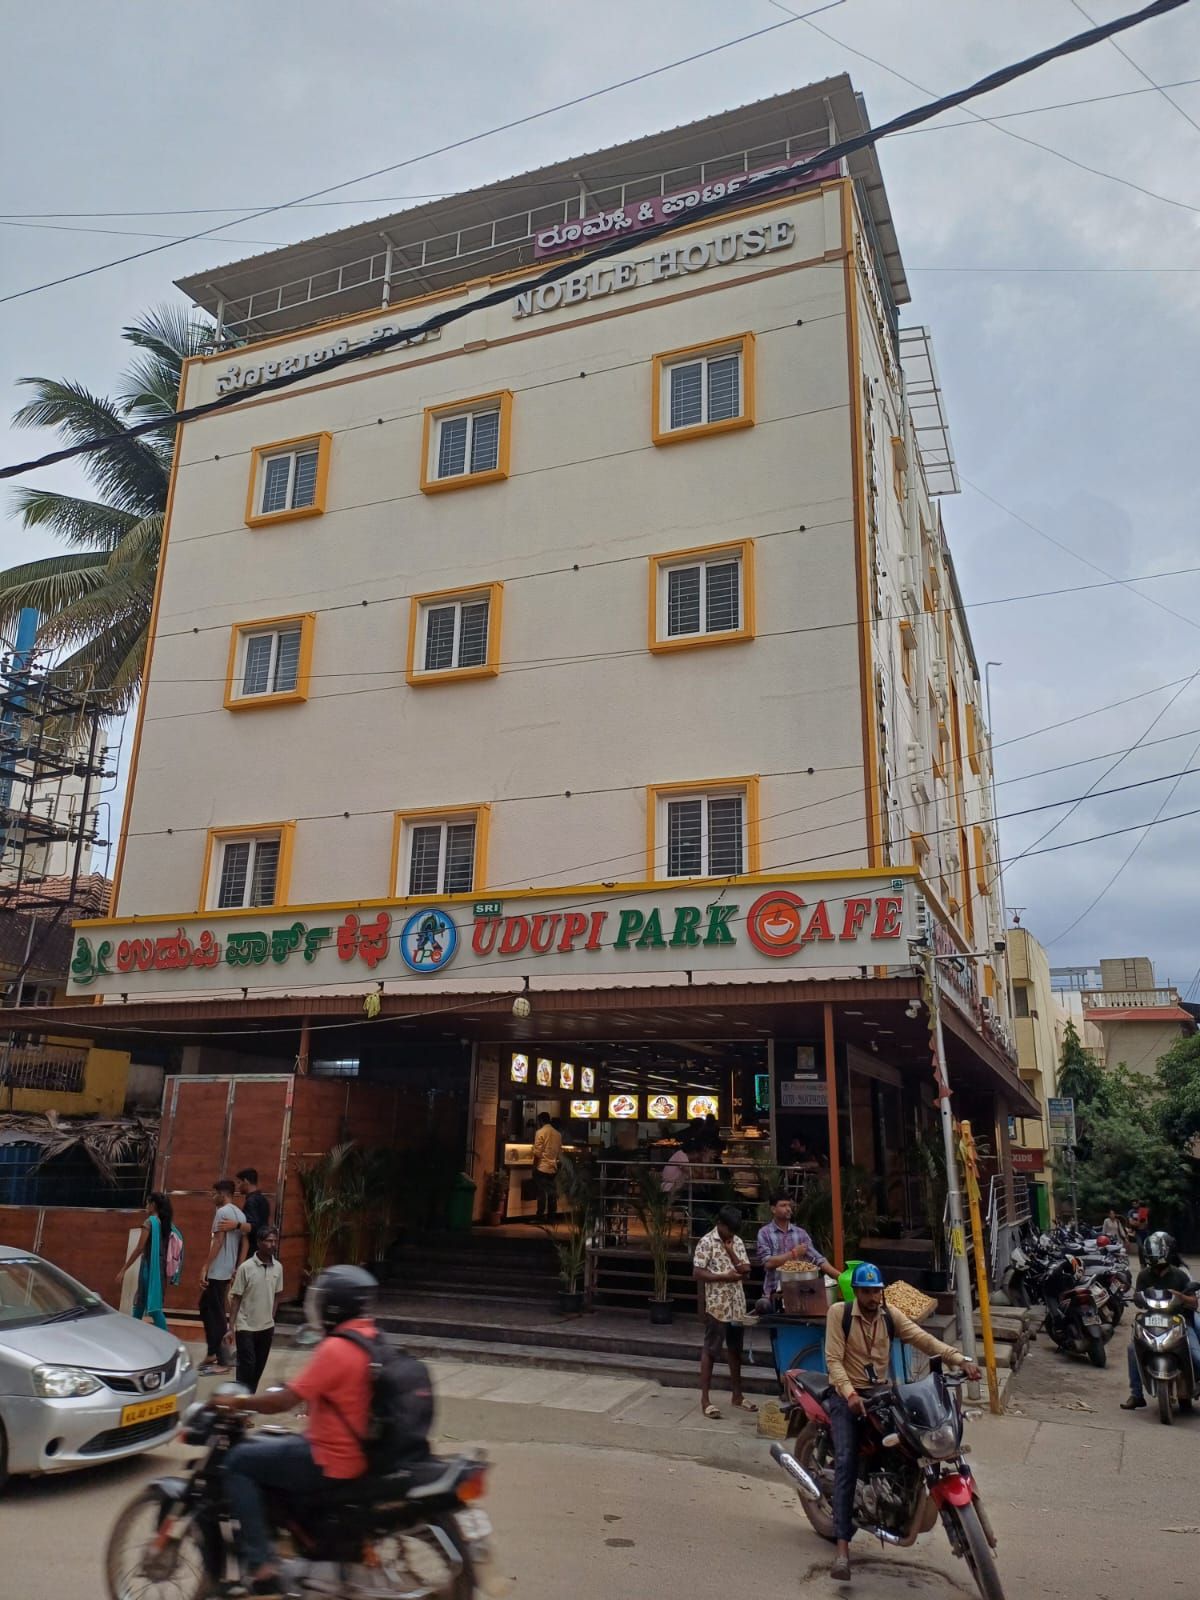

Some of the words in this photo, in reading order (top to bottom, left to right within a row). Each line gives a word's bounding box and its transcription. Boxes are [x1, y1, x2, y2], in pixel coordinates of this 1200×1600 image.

[638, 202, 654, 221] &
[512, 262, 639, 318] NOBLE
[651, 217, 796, 280] HOUSE
[471, 911, 609, 956] UDUPI
[613, 904, 738, 950] PARK
[746, 889, 903, 958] CAFE
[475, 903, 499, 913] SRI
[71, 937, 116, 985] ಶ್ರೀ
[117, 927, 220, 971] ಉಡುಪಿ
[225, 921, 334, 965] ಪಾರ್ಕ್
